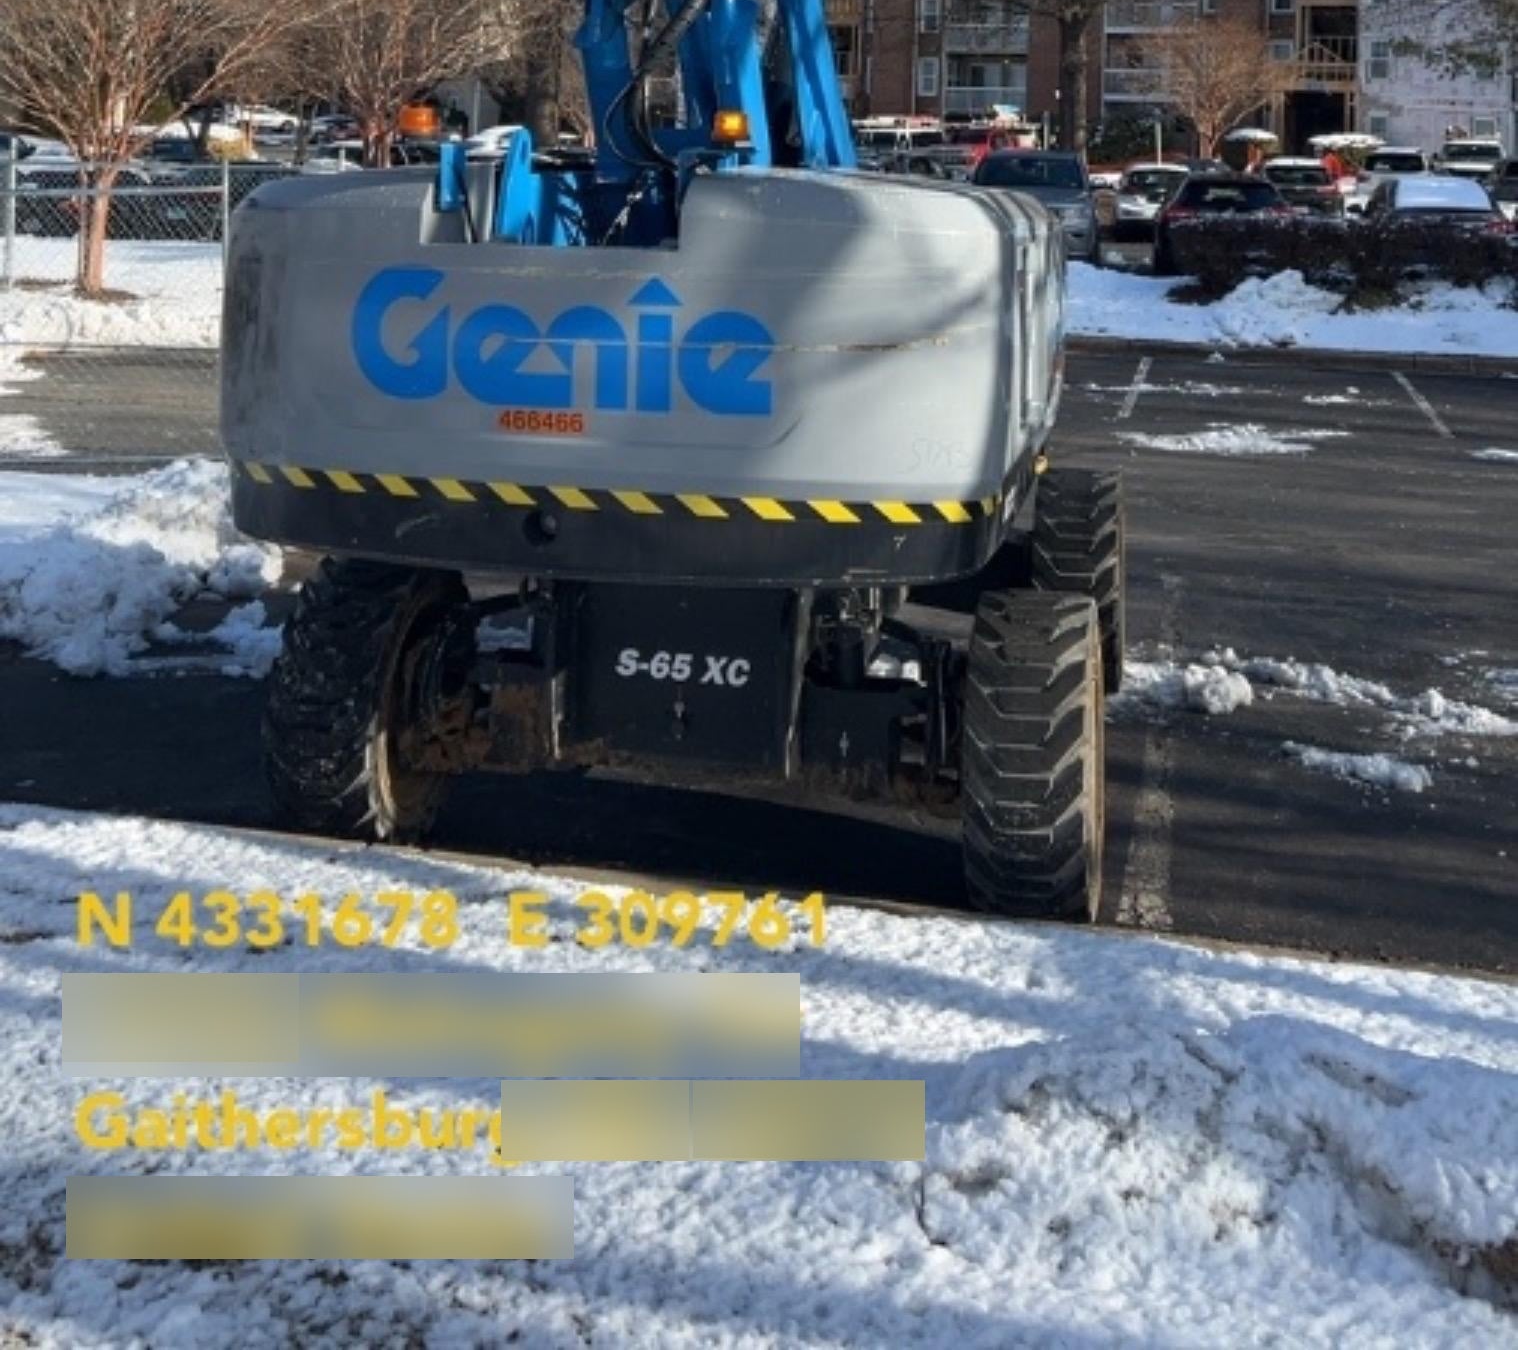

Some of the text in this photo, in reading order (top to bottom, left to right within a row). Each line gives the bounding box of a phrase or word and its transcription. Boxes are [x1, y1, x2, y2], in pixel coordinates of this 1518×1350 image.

[351, 263, 776, 416] Genie
[615, 647, 751, 687] S-65 XC
